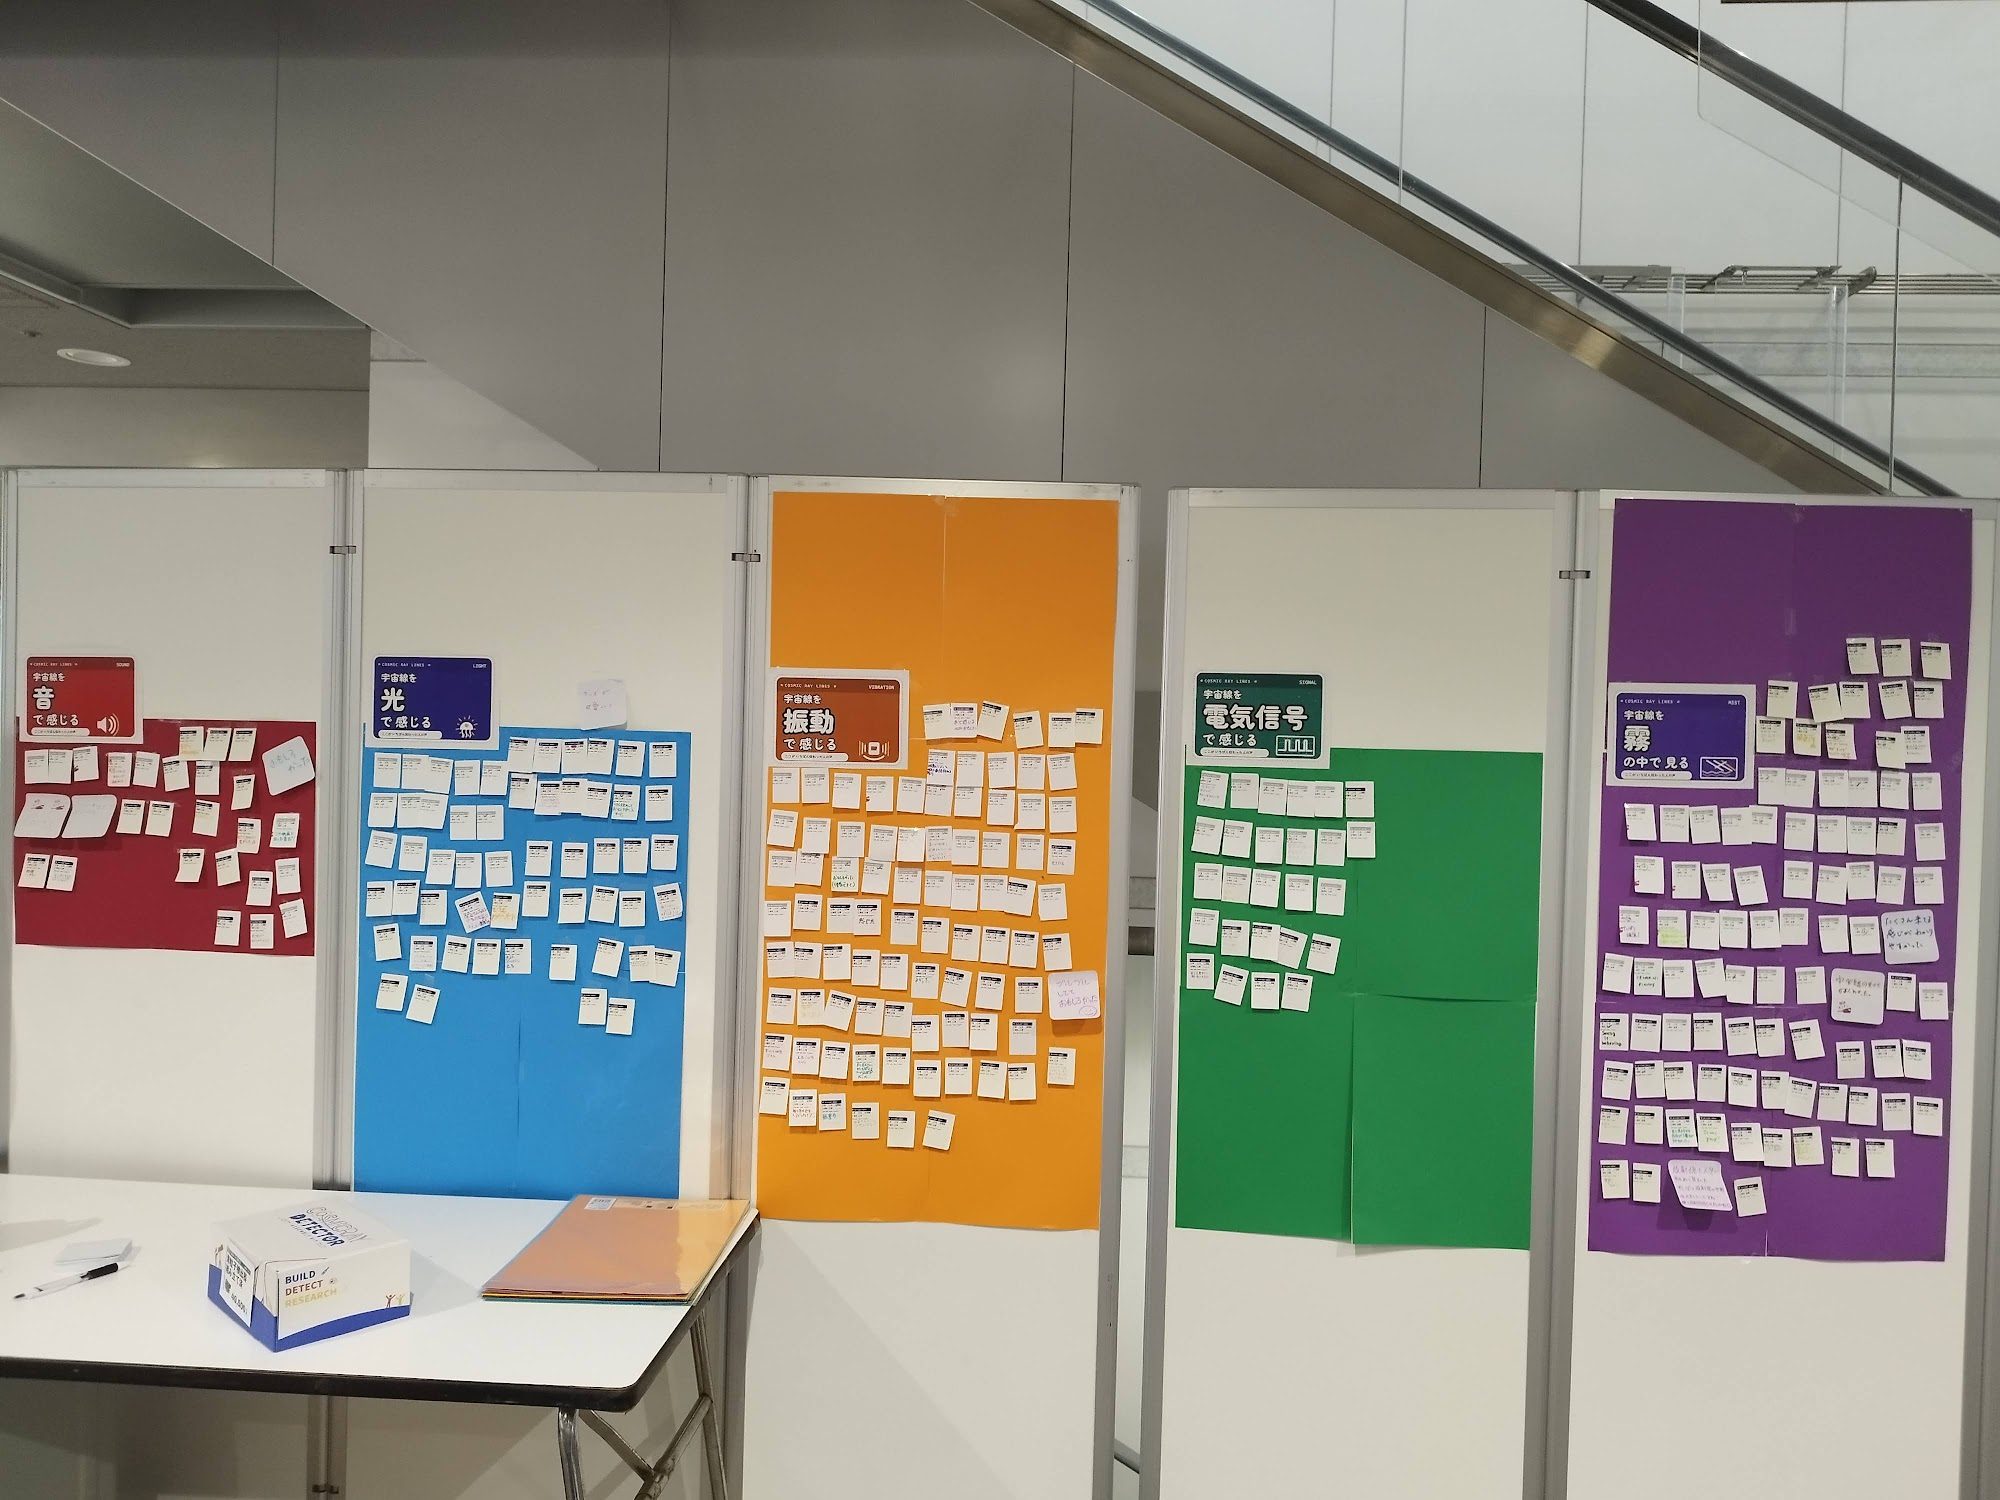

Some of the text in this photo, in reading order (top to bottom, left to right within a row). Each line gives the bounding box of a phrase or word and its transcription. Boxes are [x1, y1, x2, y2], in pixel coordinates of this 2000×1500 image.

[33, 672, 65, 682] 宇宙線を
[381, 673, 417, 683] 宇宙線を
[32, 685, 55, 710] 音
[381, 687, 405, 712] 光
[783, 694, 822, 704] 宇宙線を
[1203, 689, 1242, 700] 宇宙線を
[33, 713, 79, 726] で感じる
[380, 715, 431, 729] で感じる
[783, 708, 835, 735] 振動
[1203, 703, 1308, 731] 電気信号
[1623, 710, 1664, 721] 宇宙線を
[783, 738, 837, 751] で感じる
[1202, 733, 1257, 747] で感じる
[1623, 725, 1651, 752] 霧
[1623, 756, 1689, 769] の中で見る
[289, 1213, 345, 1247] DETECTOR
[285, 1270, 316, 1284] BUILD
[285, 1279, 324, 1297] DETECT
[285, 1288, 337, 1308] RESEARCH
